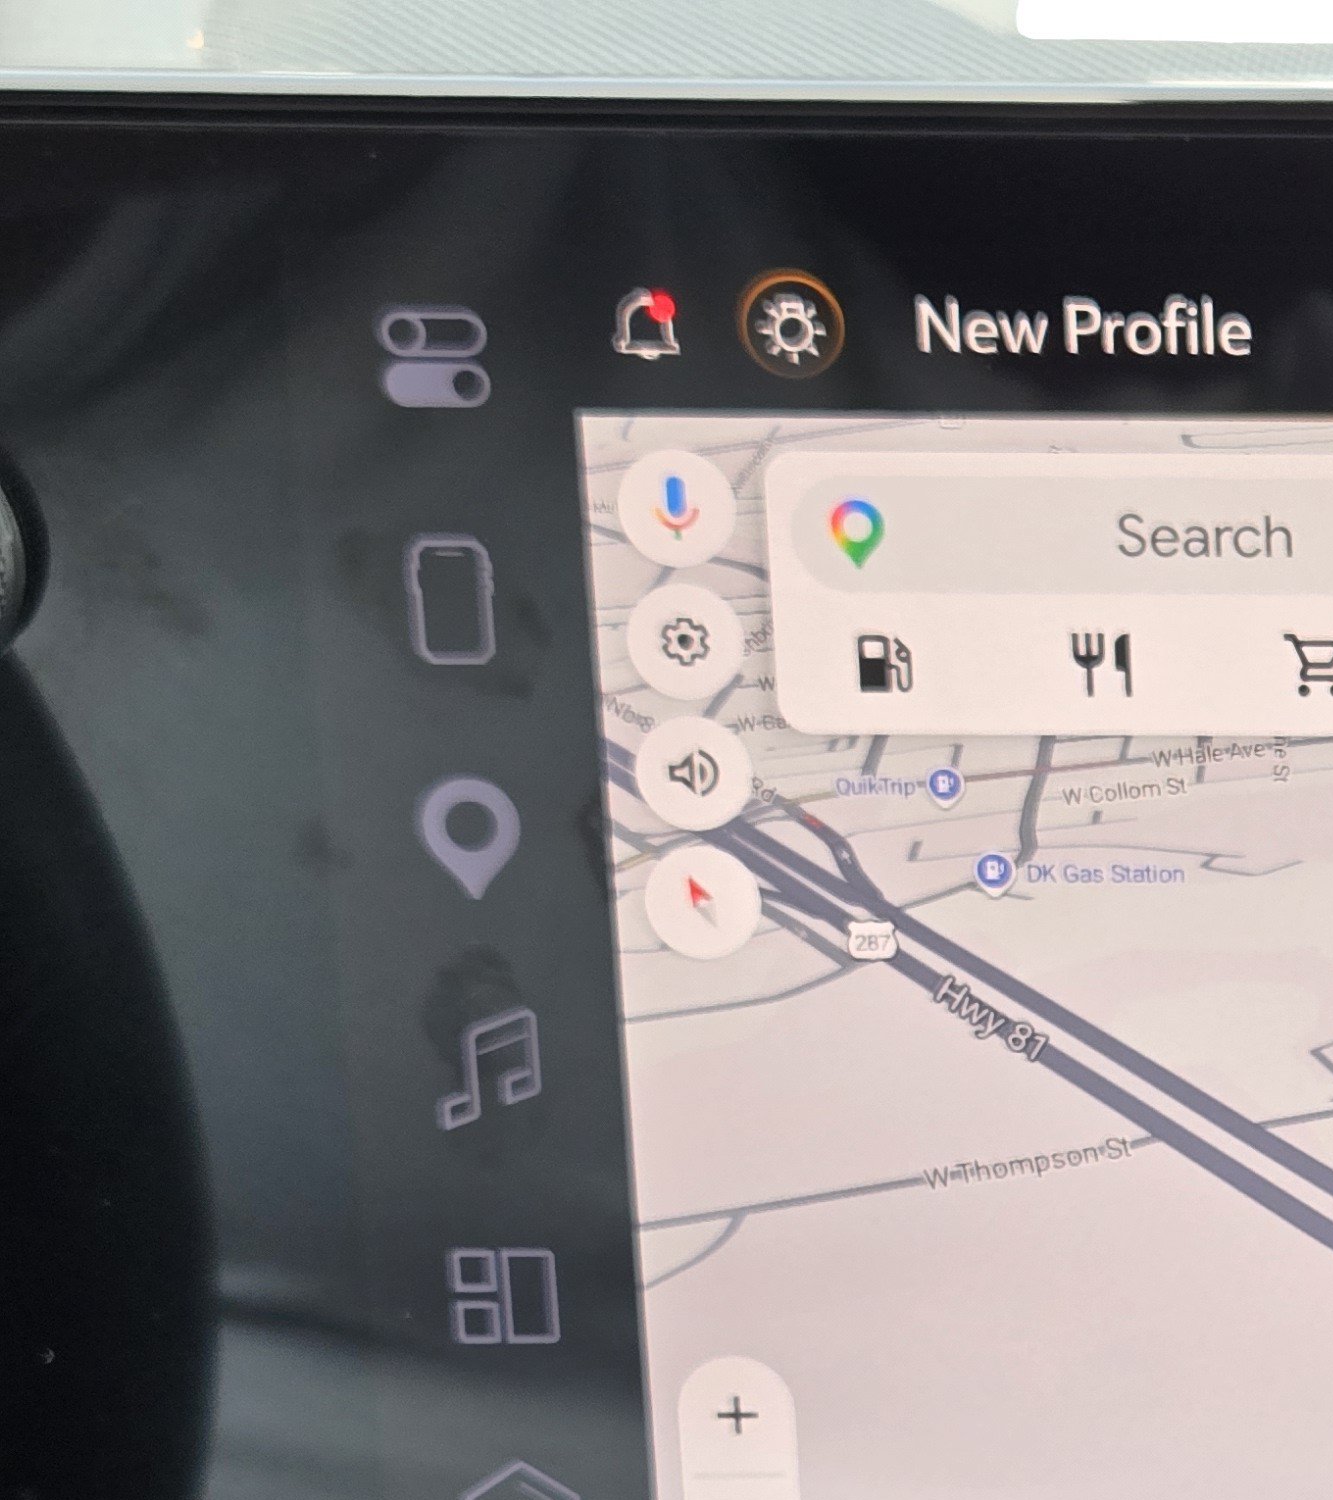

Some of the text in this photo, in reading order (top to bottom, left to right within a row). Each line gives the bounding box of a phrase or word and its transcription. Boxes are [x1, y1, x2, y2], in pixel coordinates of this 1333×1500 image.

[914, 294, 1253, 356] New Profile
[1115, 512, 1294, 559] Search
[1151, 742, 1266, 768] W Hale Ave
[1273, 764, 1290, 783] St
[1061, 777, 1187, 806] W Collom St
[1027, 863, 1186, 884] DK Gas Station
[853, 933, 892, 953] 287
[934, 975, 1051, 1061] Hwy 81
[922, 1136, 1133, 1191] W Thompson St
